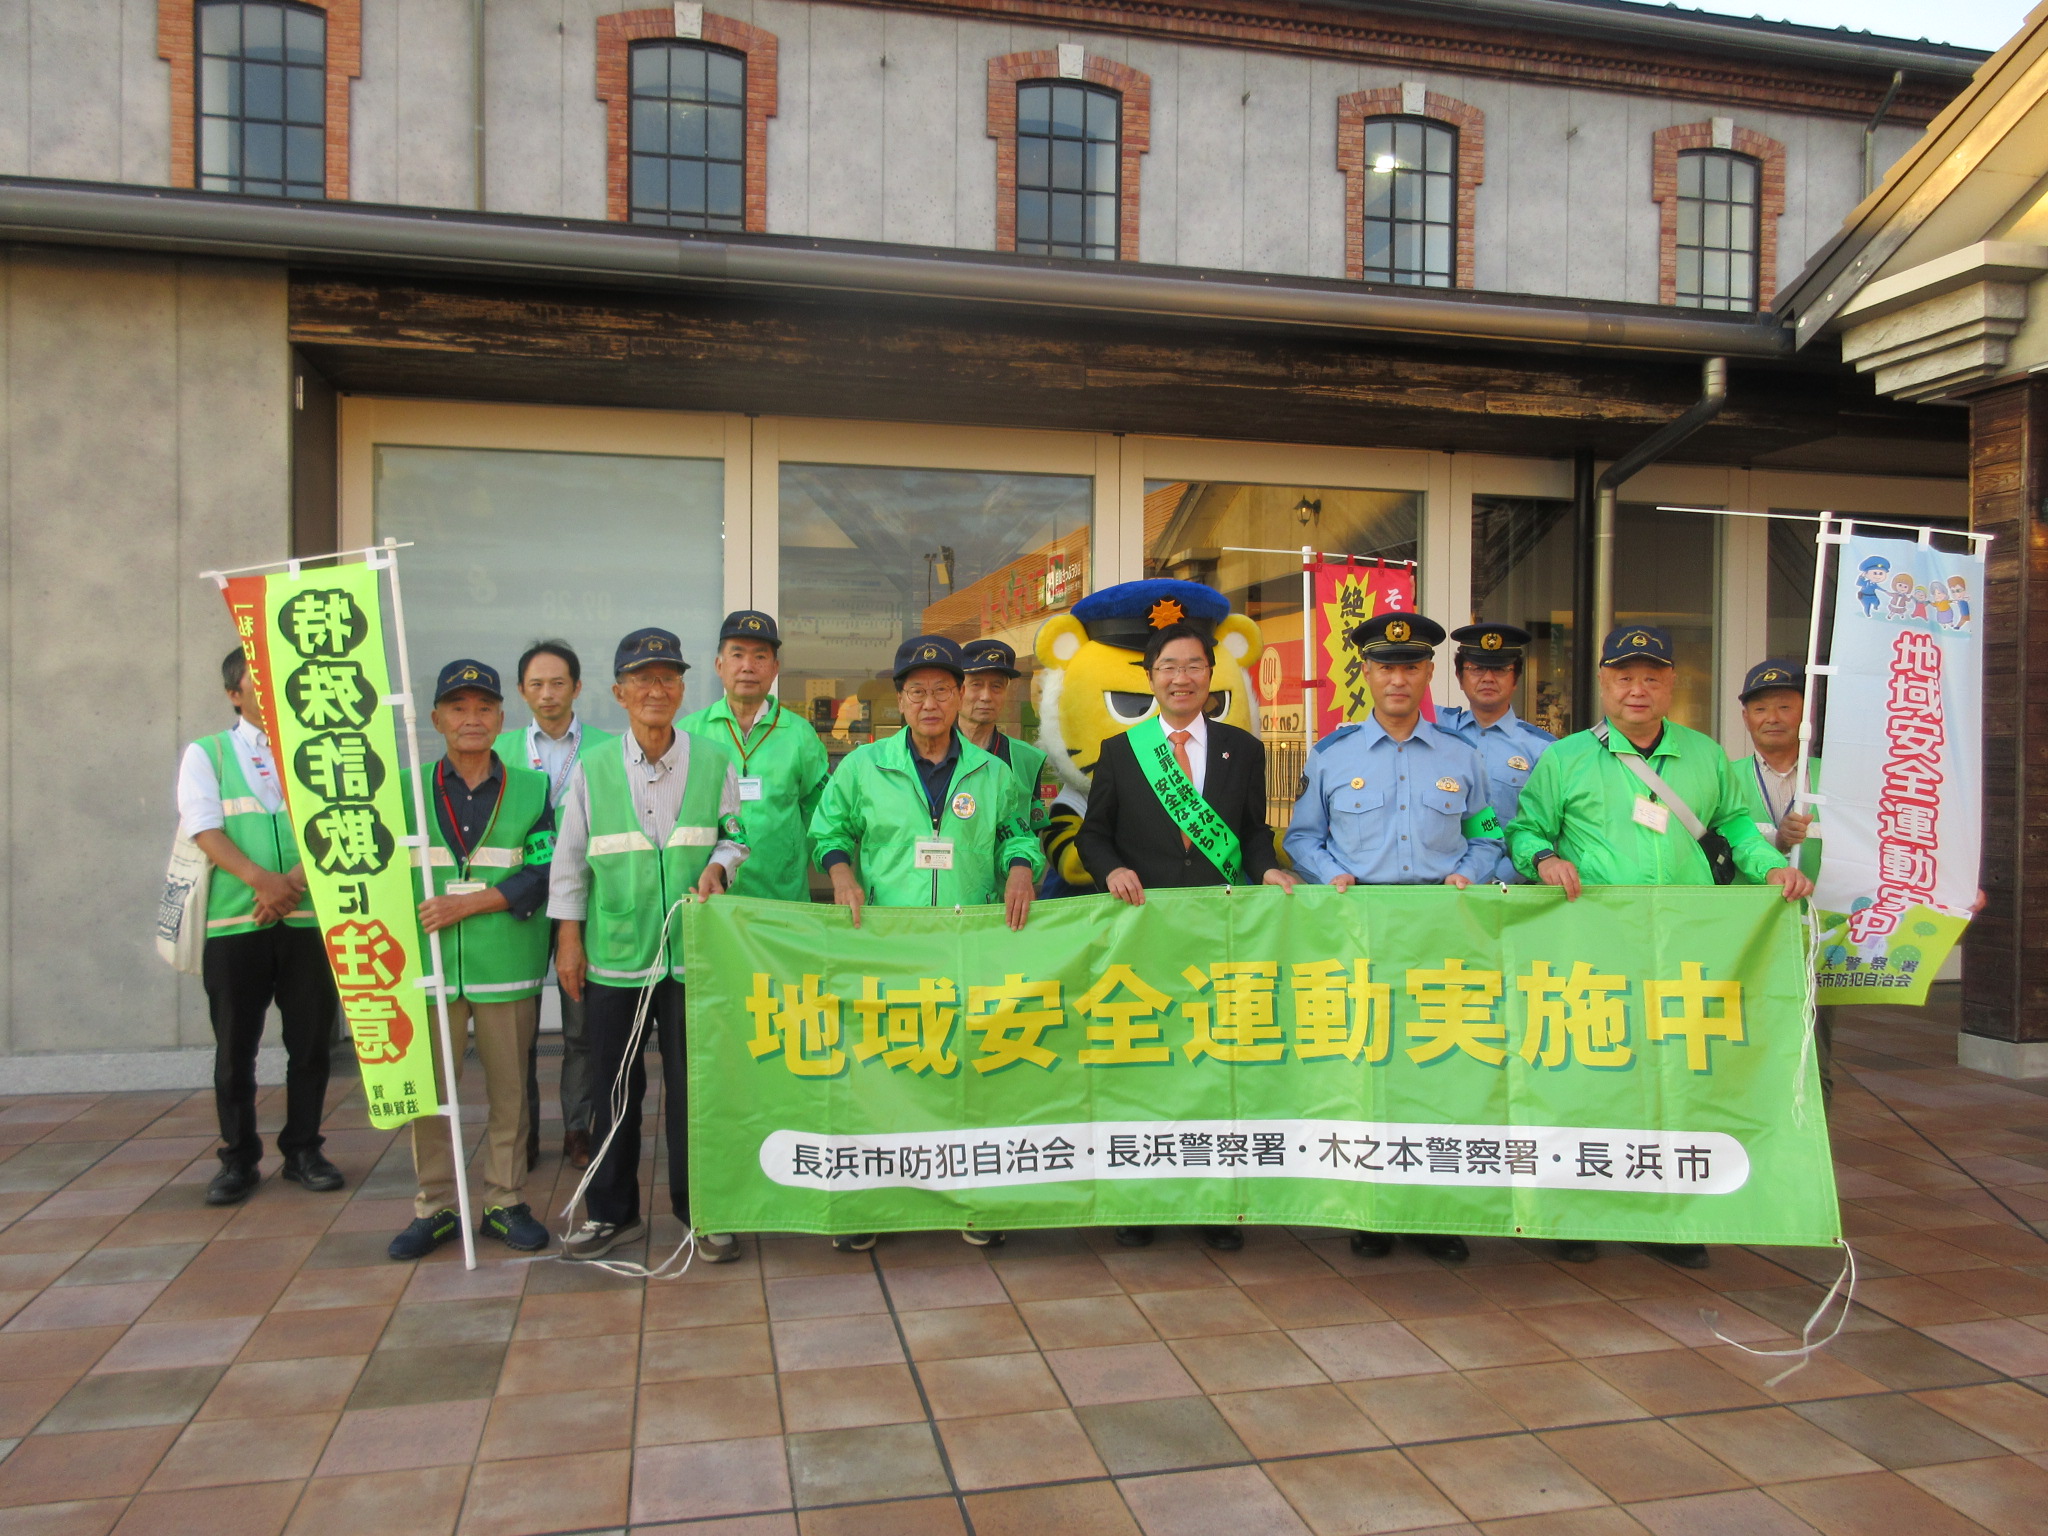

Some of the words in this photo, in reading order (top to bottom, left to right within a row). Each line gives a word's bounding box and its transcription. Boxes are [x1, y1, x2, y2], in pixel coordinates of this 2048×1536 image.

[745, 957, 1746, 1077] 地域安全運動実施中
